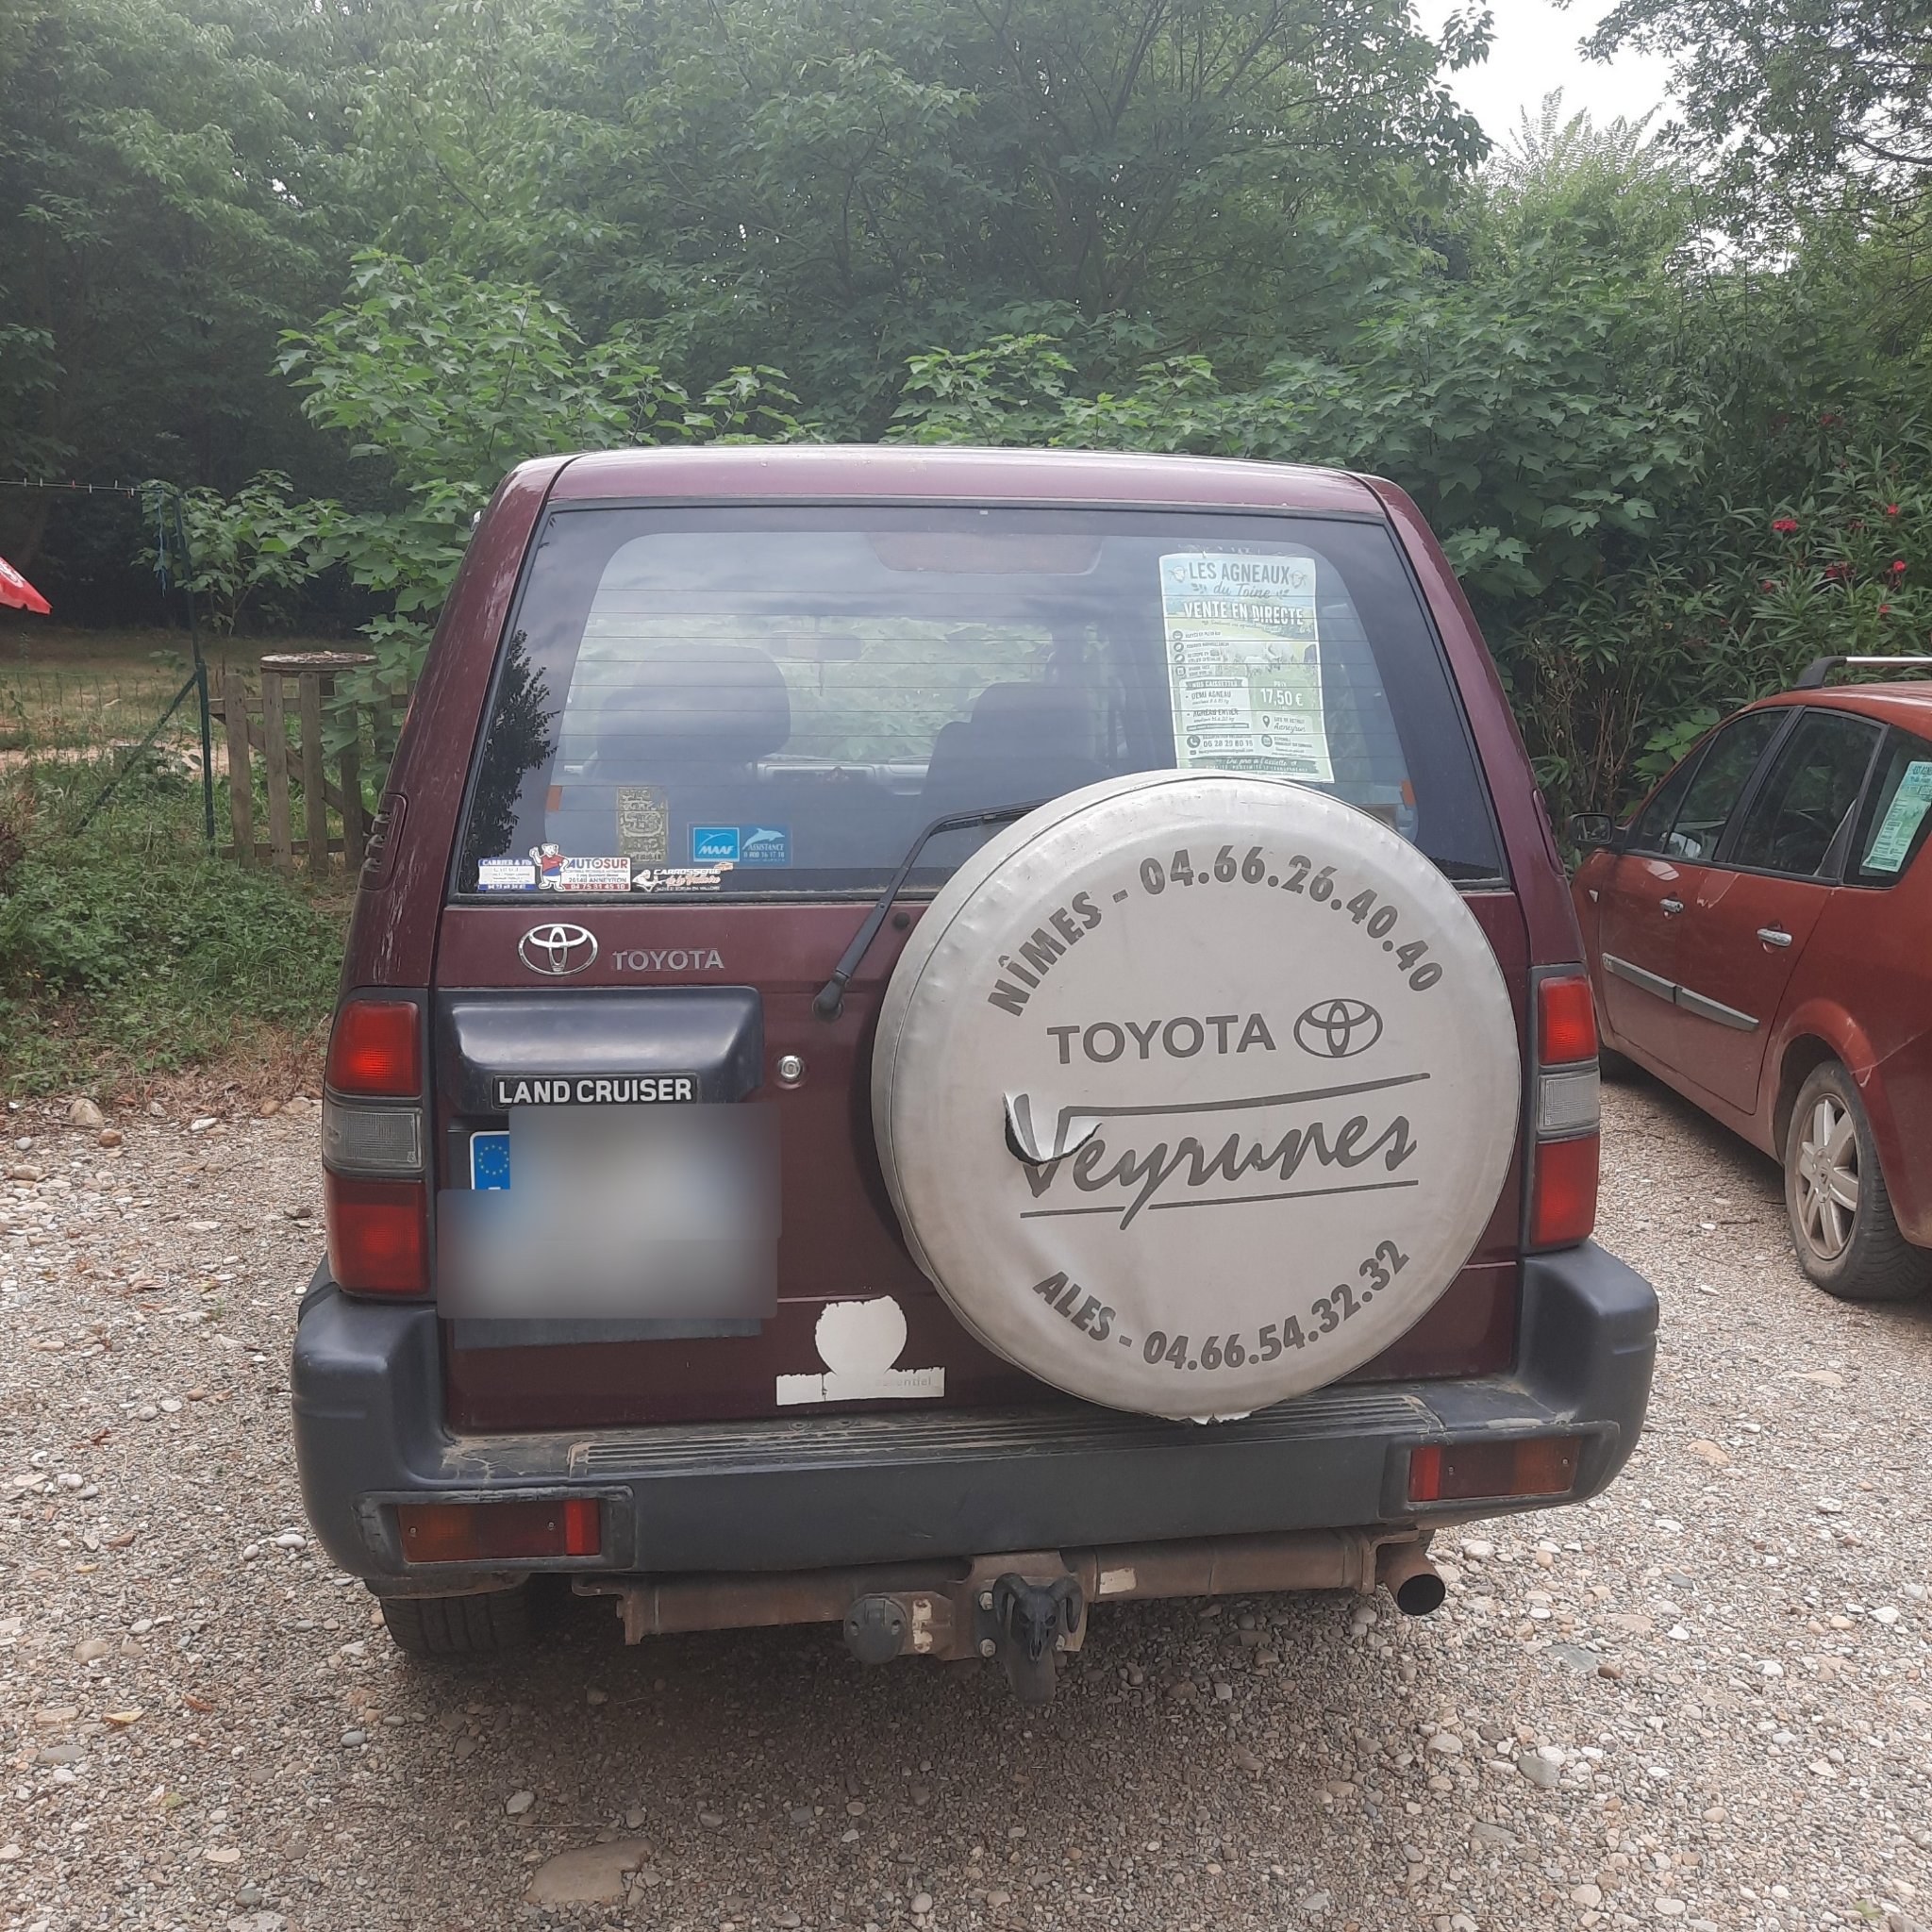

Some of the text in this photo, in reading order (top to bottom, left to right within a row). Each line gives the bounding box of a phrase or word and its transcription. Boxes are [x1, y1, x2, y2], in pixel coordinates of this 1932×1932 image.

[1189, 561, 1291, 586] LES AGNEAUX
[1213, 581, 1271, 599] du Toine
[1184, 600, 1228, 619] VENTE
[1232, 603, 1247, 620] EN
[1251, 605, 1304, 625] DIRECTE
[1191, 690, 1231, 700] DEMI AGNEAU
[1260, 688, 1304, 707] 17,50 €
[698, 845, 734, 855] MAAF
[566, 858, 628, 869] AUTOSUR
[988, 890, 1102, 1017] NÎMES
[1139, 844, 1443, 992] 04.66.26.40.40
[612, 949, 725, 971] TOYOTA
[1046, 1013, 1276, 1065] TOYOTA
[498, 1078, 693, 1104] LAND CRUISER
[1009, 1092, 1419, 1230] Veyrunes
[1033, 1271, 1116, 1341] ALES
[1143, 1239, 1410, 1371] 04.66.54.32.32
